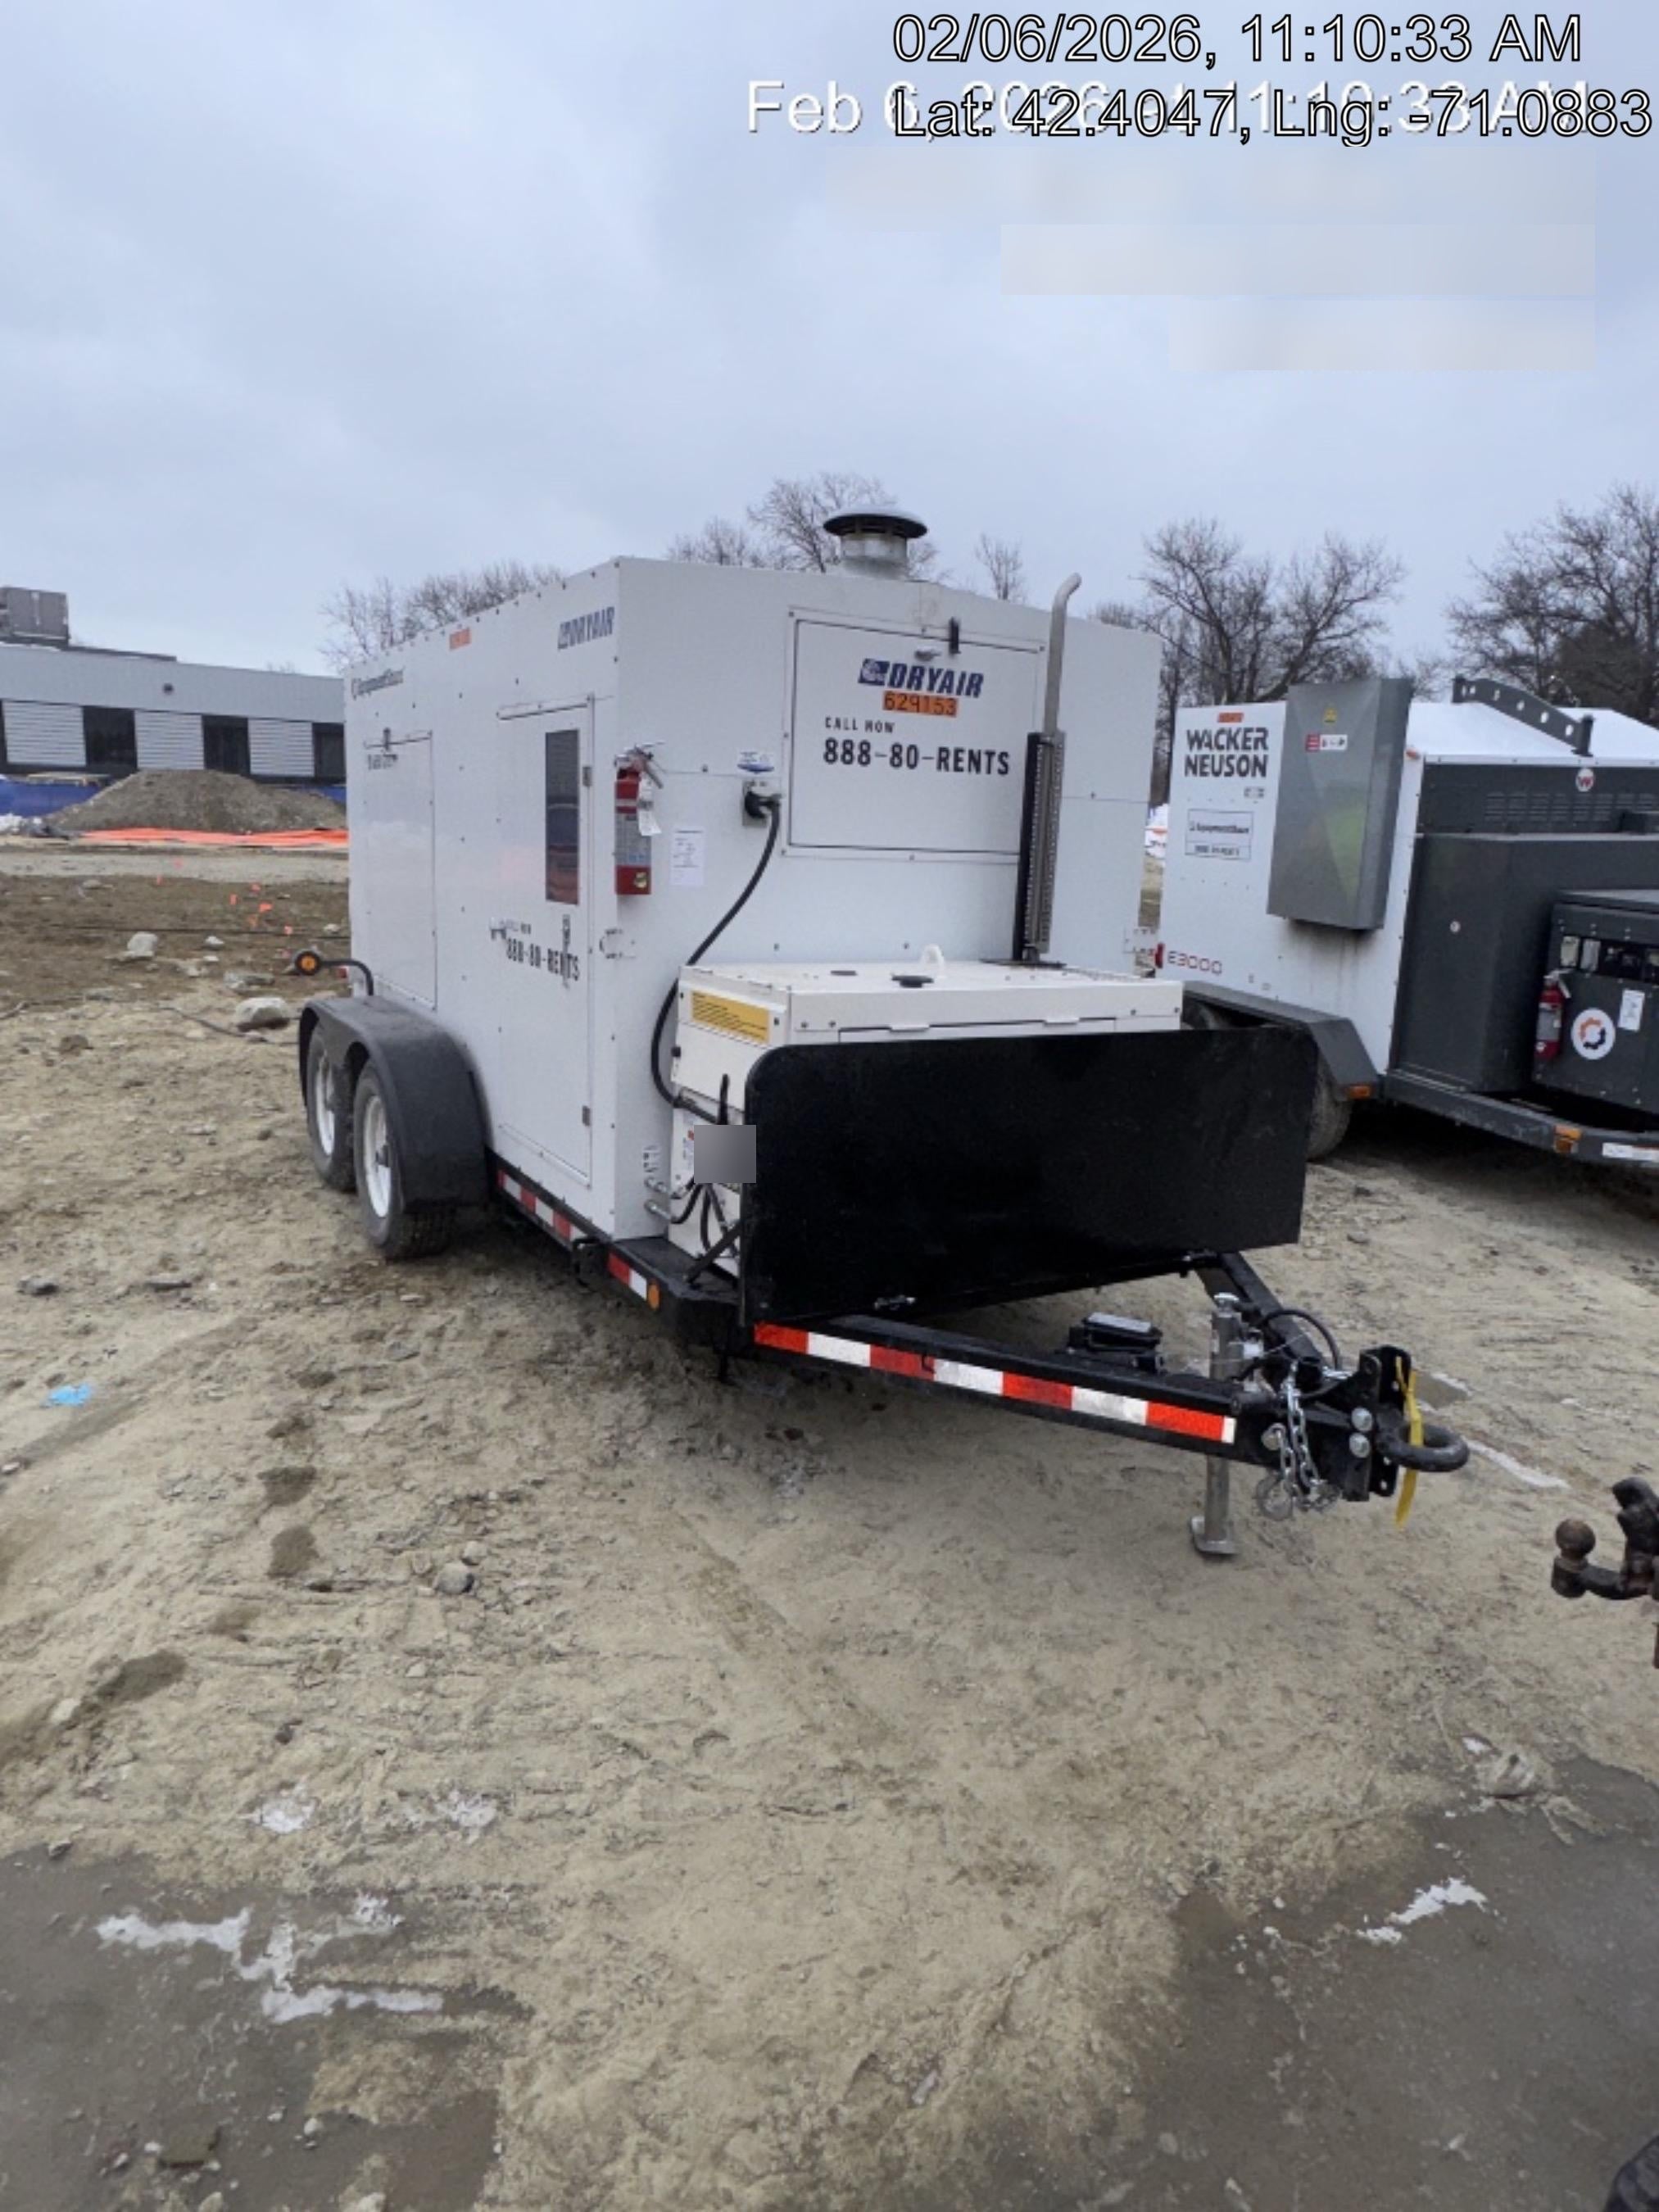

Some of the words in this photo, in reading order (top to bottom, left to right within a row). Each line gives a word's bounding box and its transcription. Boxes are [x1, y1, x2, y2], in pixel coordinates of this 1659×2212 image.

[887, 663, 985, 699] DRYAIR
[884, 691, 957, 716] 629153
[825, 715, 858, 731] CALL
[1185, 727, 1270, 752] WACKER
[823, 737, 1010, 776] 888-80-RENTS
[1184, 754, 1269, 778] NEUSON
[1167, 950, 1223, 976] E3000
